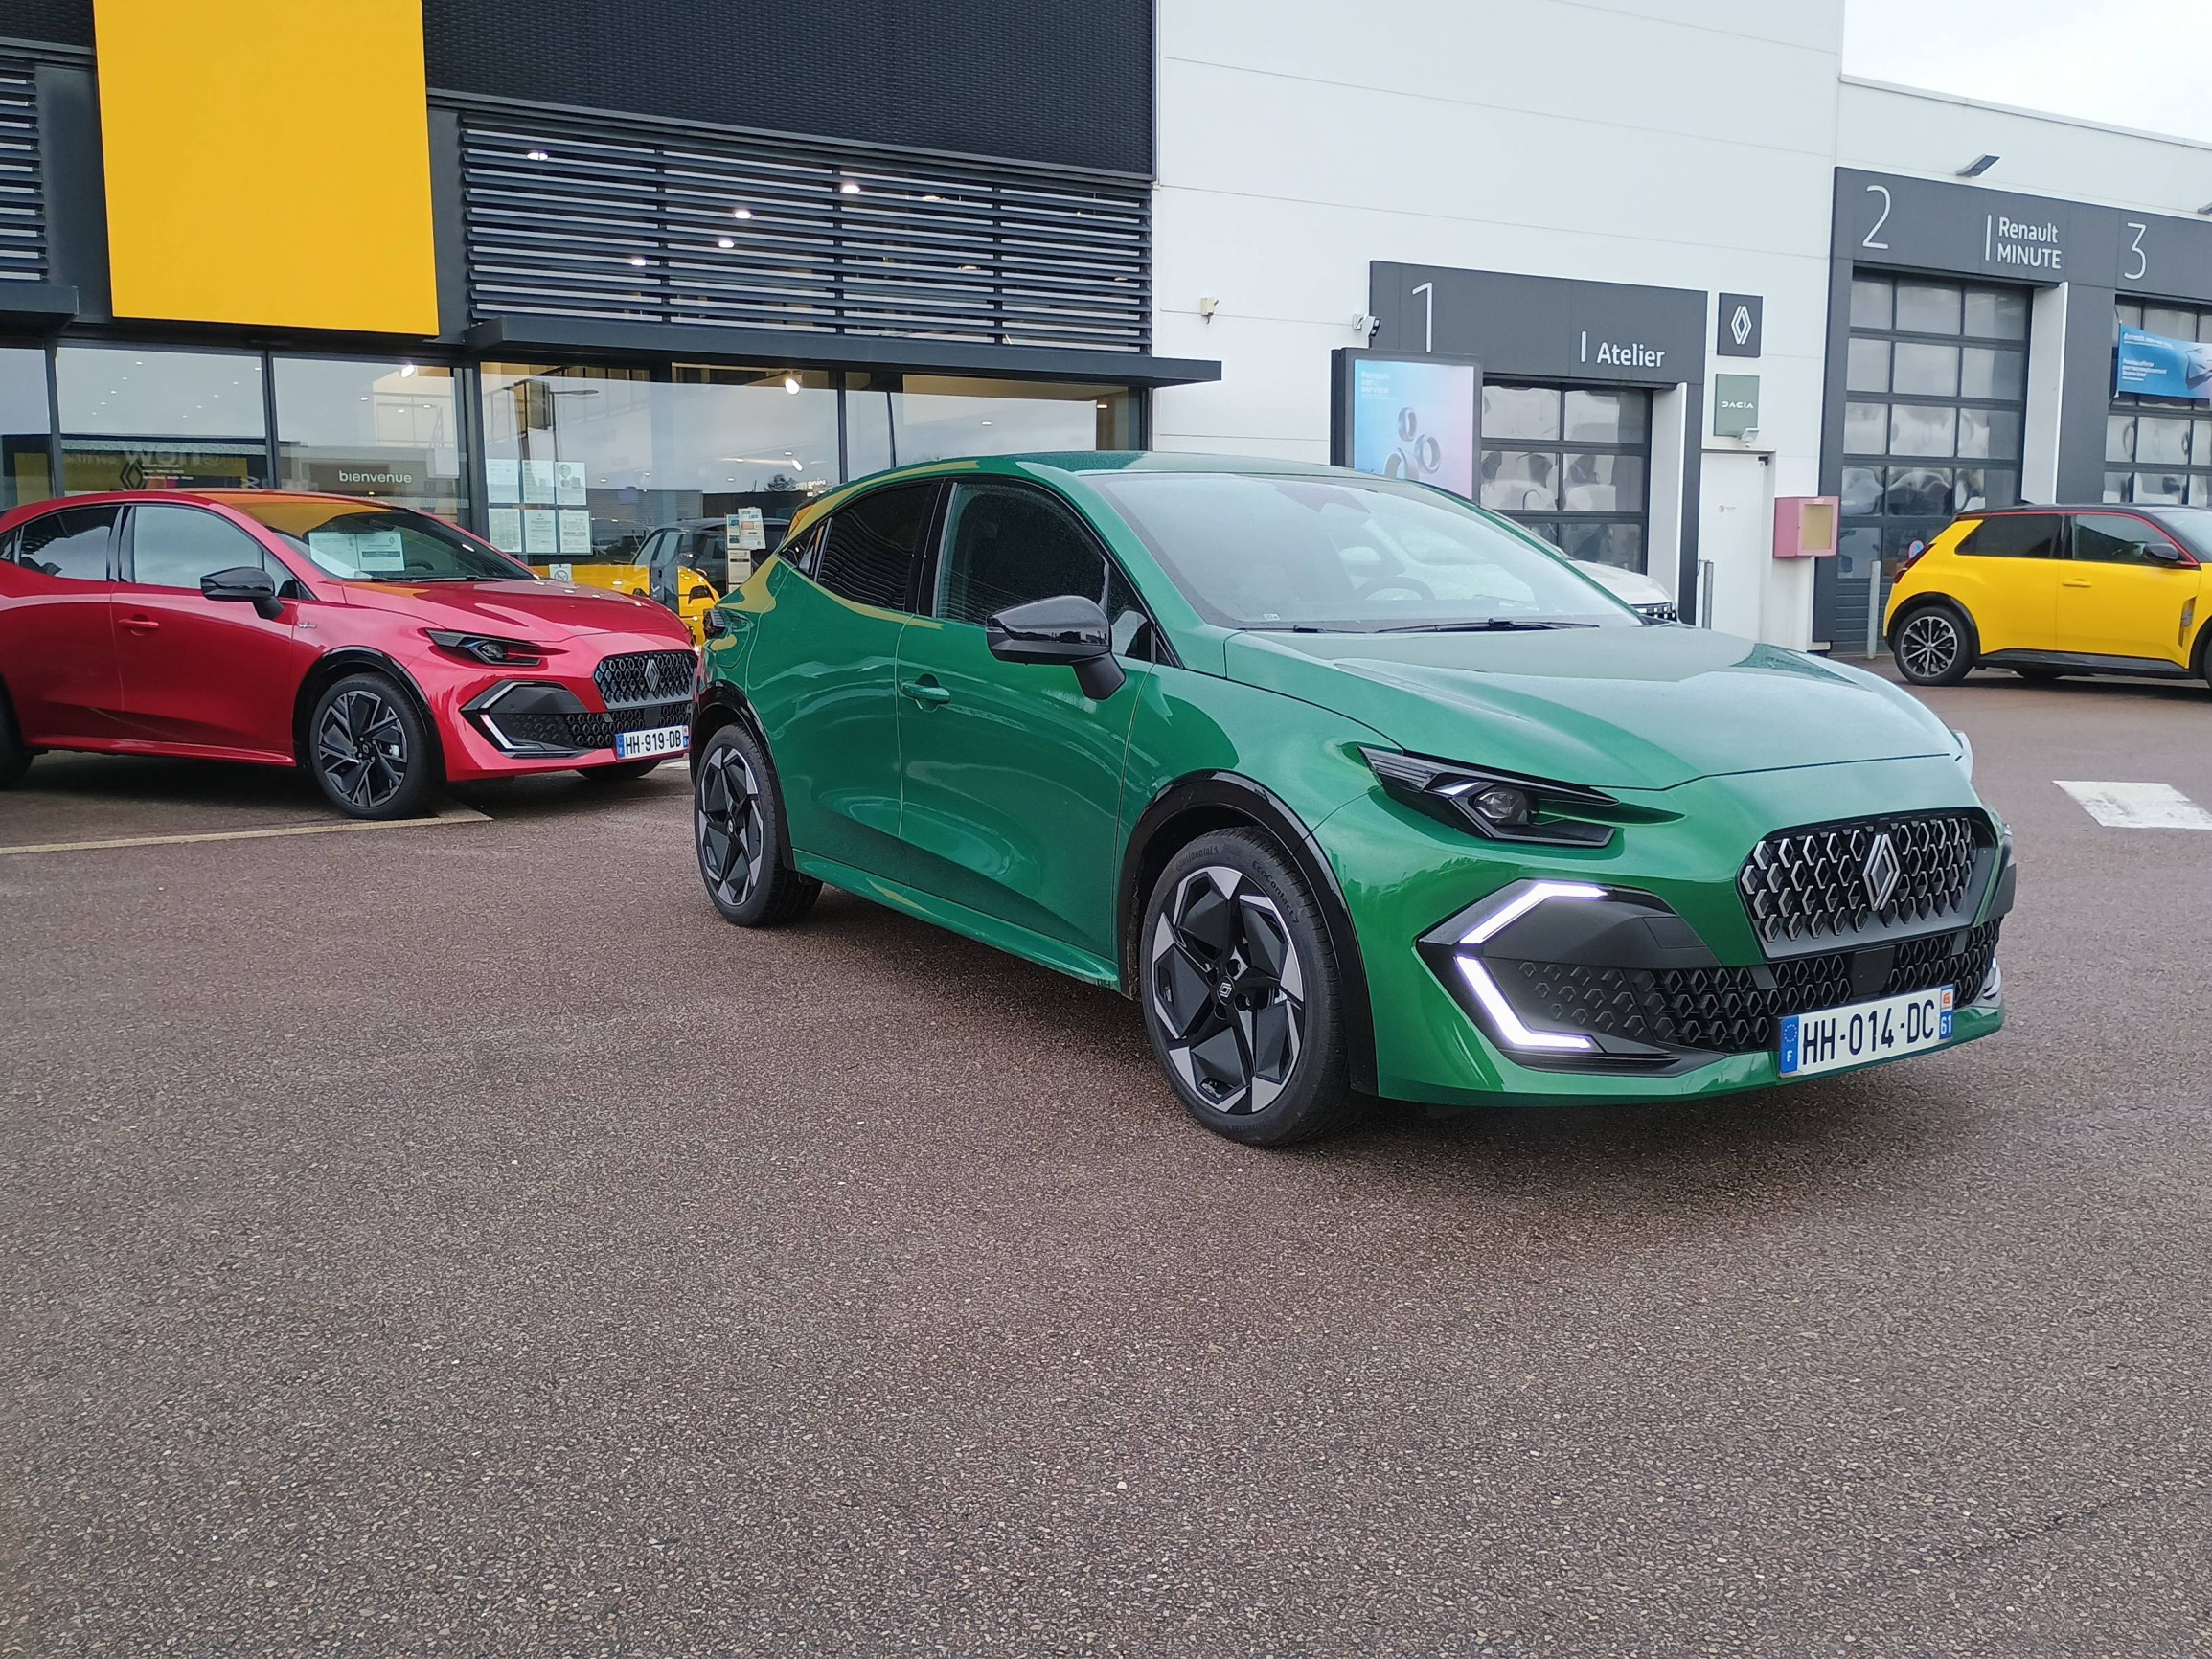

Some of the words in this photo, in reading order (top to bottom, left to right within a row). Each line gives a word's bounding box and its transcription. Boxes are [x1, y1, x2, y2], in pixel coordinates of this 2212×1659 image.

[1862, 185, 1891, 249] 2
[1998, 216, 2059, 244] Renault
[1997, 243, 2062, 269] MINUTE
[2124, 222, 2148, 280] 3
[1412, 282, 1433, 352] 1
[1596, 341, 1666, 368] Atelier
[1721, 400, 1754, 409] DACIA
[338, 469, 412, 484] bienvenue
[626, 729, 681, 755] HH-919-DB
[1803, 999, 1935, 1065] HH-014-DC
[1940, 1014, 1952, 1035] 61
[1786, 1049, 1793, 1063] F
